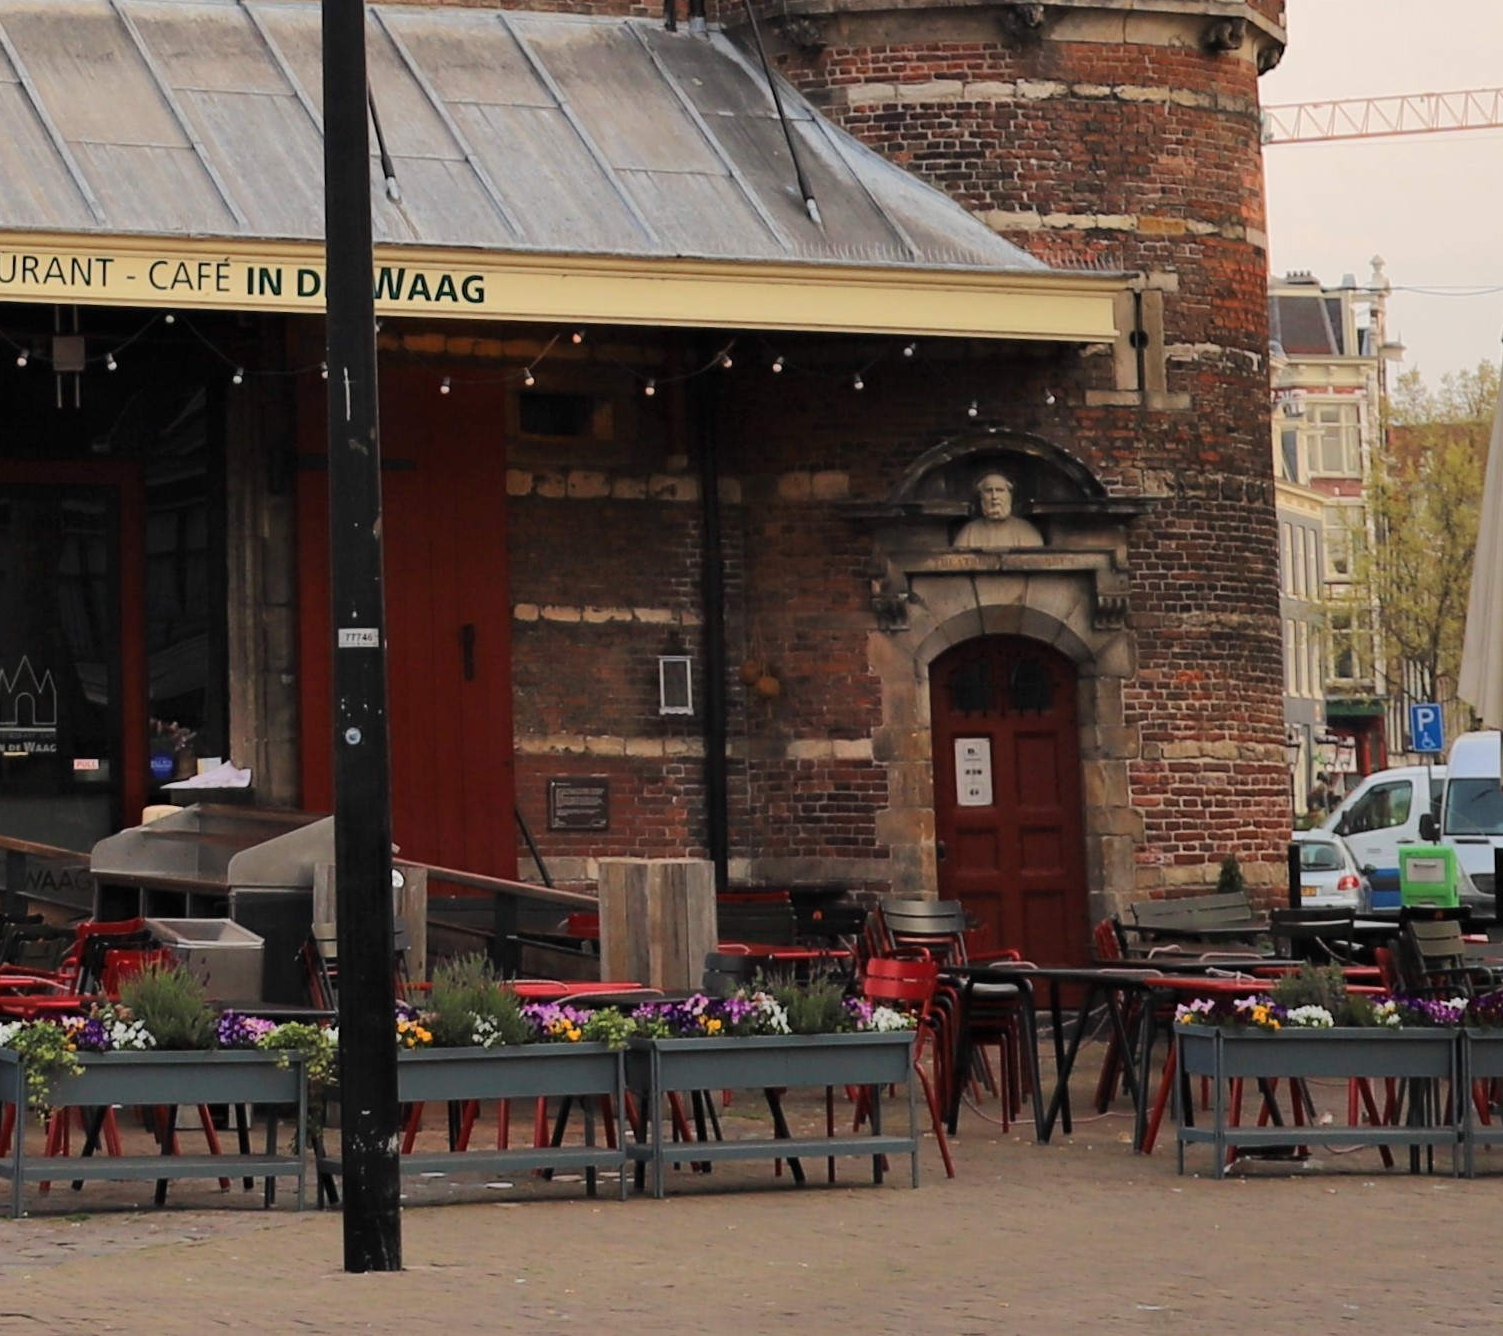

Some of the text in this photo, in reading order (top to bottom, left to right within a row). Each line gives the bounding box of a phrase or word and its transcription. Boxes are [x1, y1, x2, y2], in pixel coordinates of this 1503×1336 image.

[148, 256, 232, 293] CAFÉ
[247, 267, 282, 296] IN
[297, 268, 327, 298] D
[373, 267, 486, 304] WAAG
[345, 633, 373, 642] 77746
[1416, 707, 1435, 732] P
[75, 759, 97, 769] PULL
